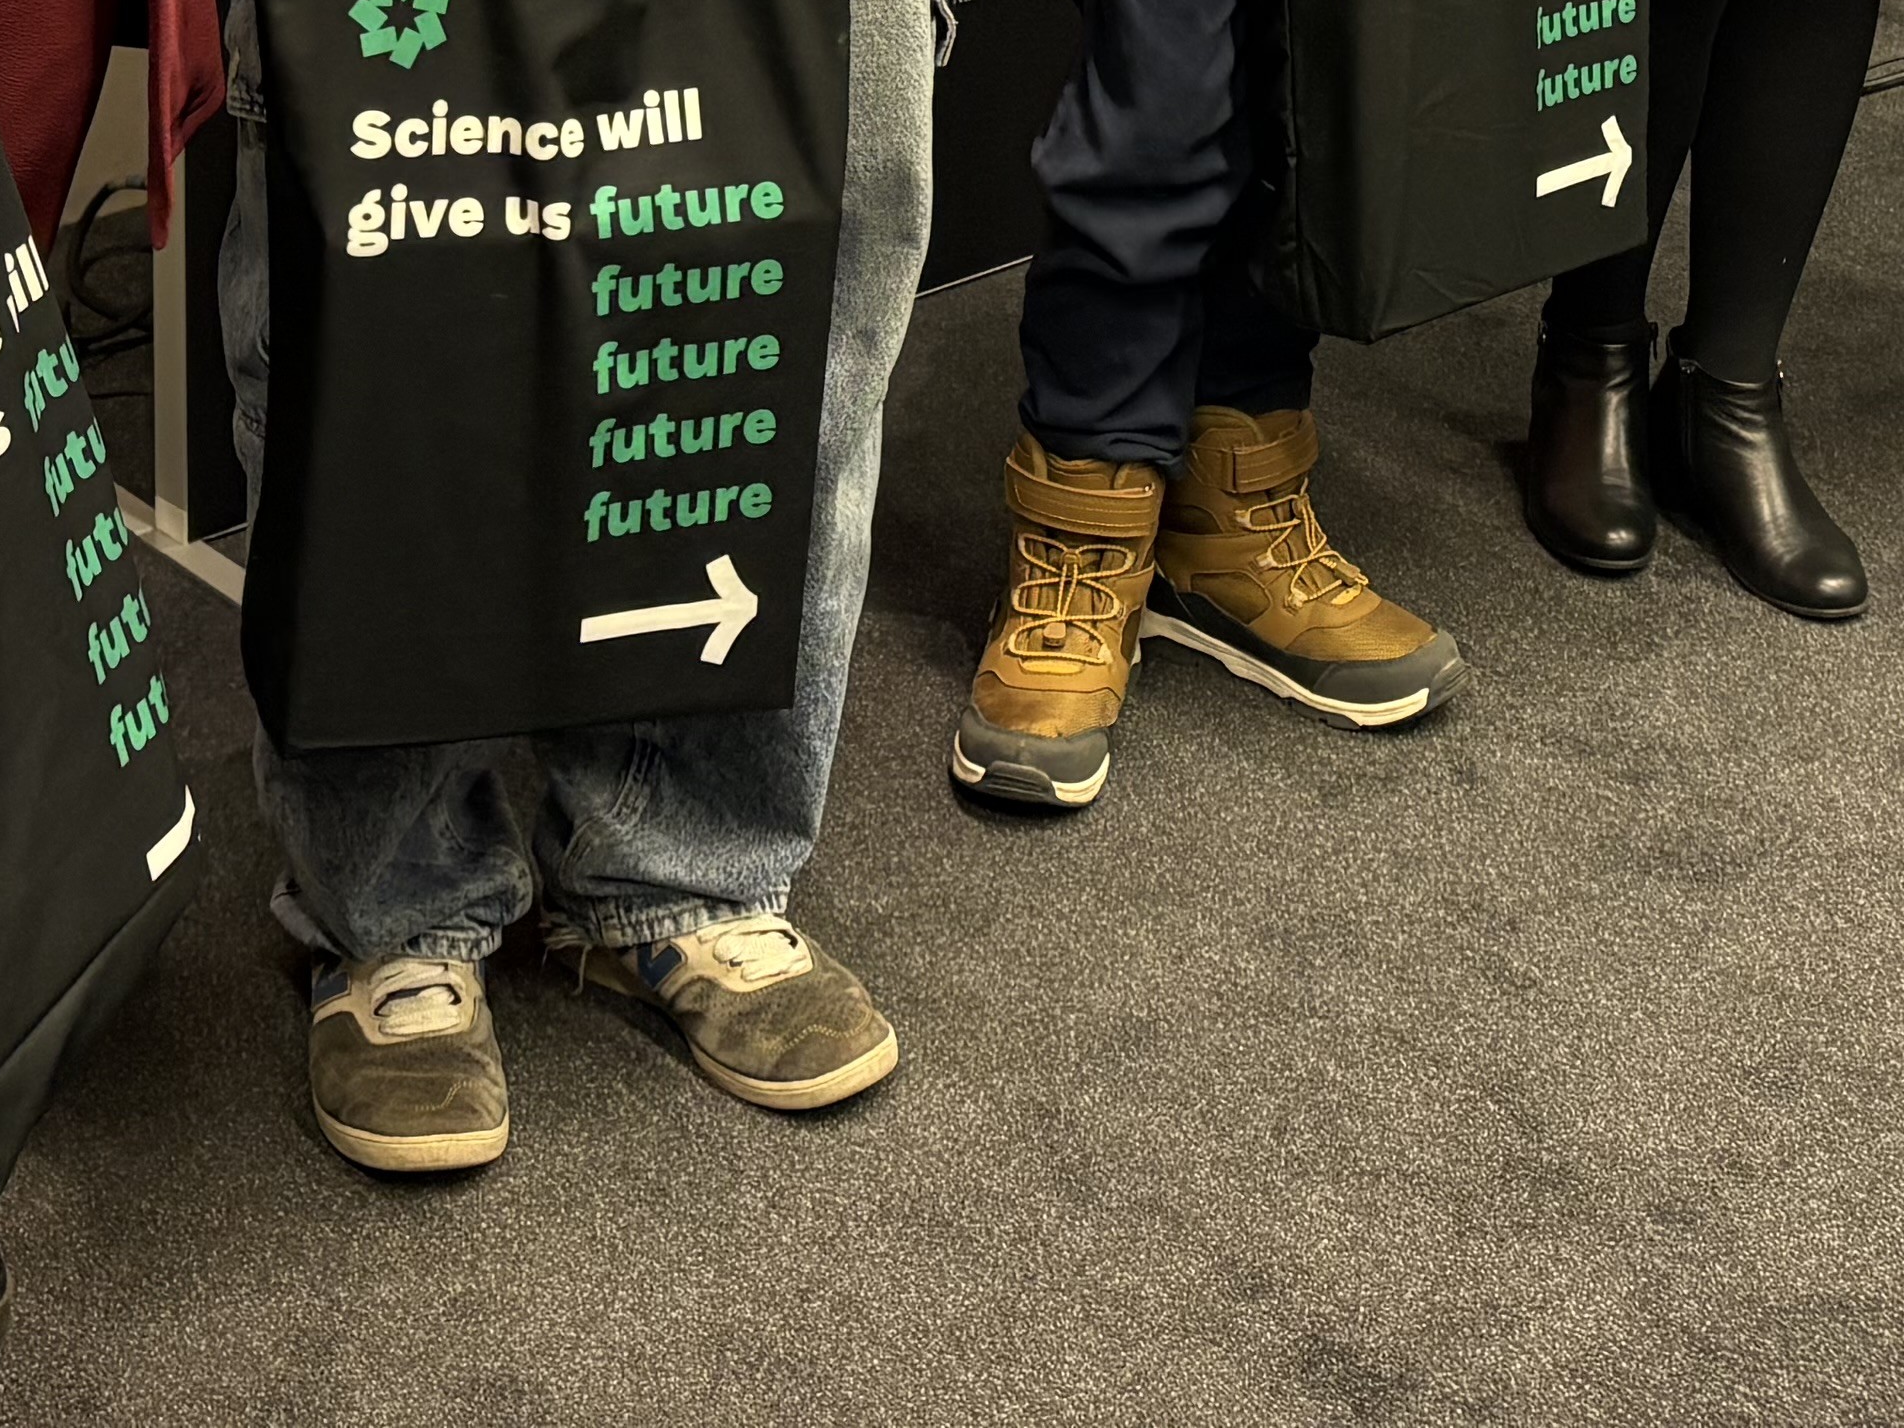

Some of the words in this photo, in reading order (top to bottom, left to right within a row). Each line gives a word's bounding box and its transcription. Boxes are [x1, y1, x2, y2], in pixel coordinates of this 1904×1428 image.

[351, 99, 585, 161] Science
[597, 87, 703, 151] will
[346, 182, 485, 257] give
[506, 196, 572, 241] us
[590, 181, 785, 240] future
[4, 234, 49, 333] ill
[592, 259, 785, 317] future
[593, 336, 782, 395] future
[589, 410, 778, 468] future
[584, 483, 774, 543] future
